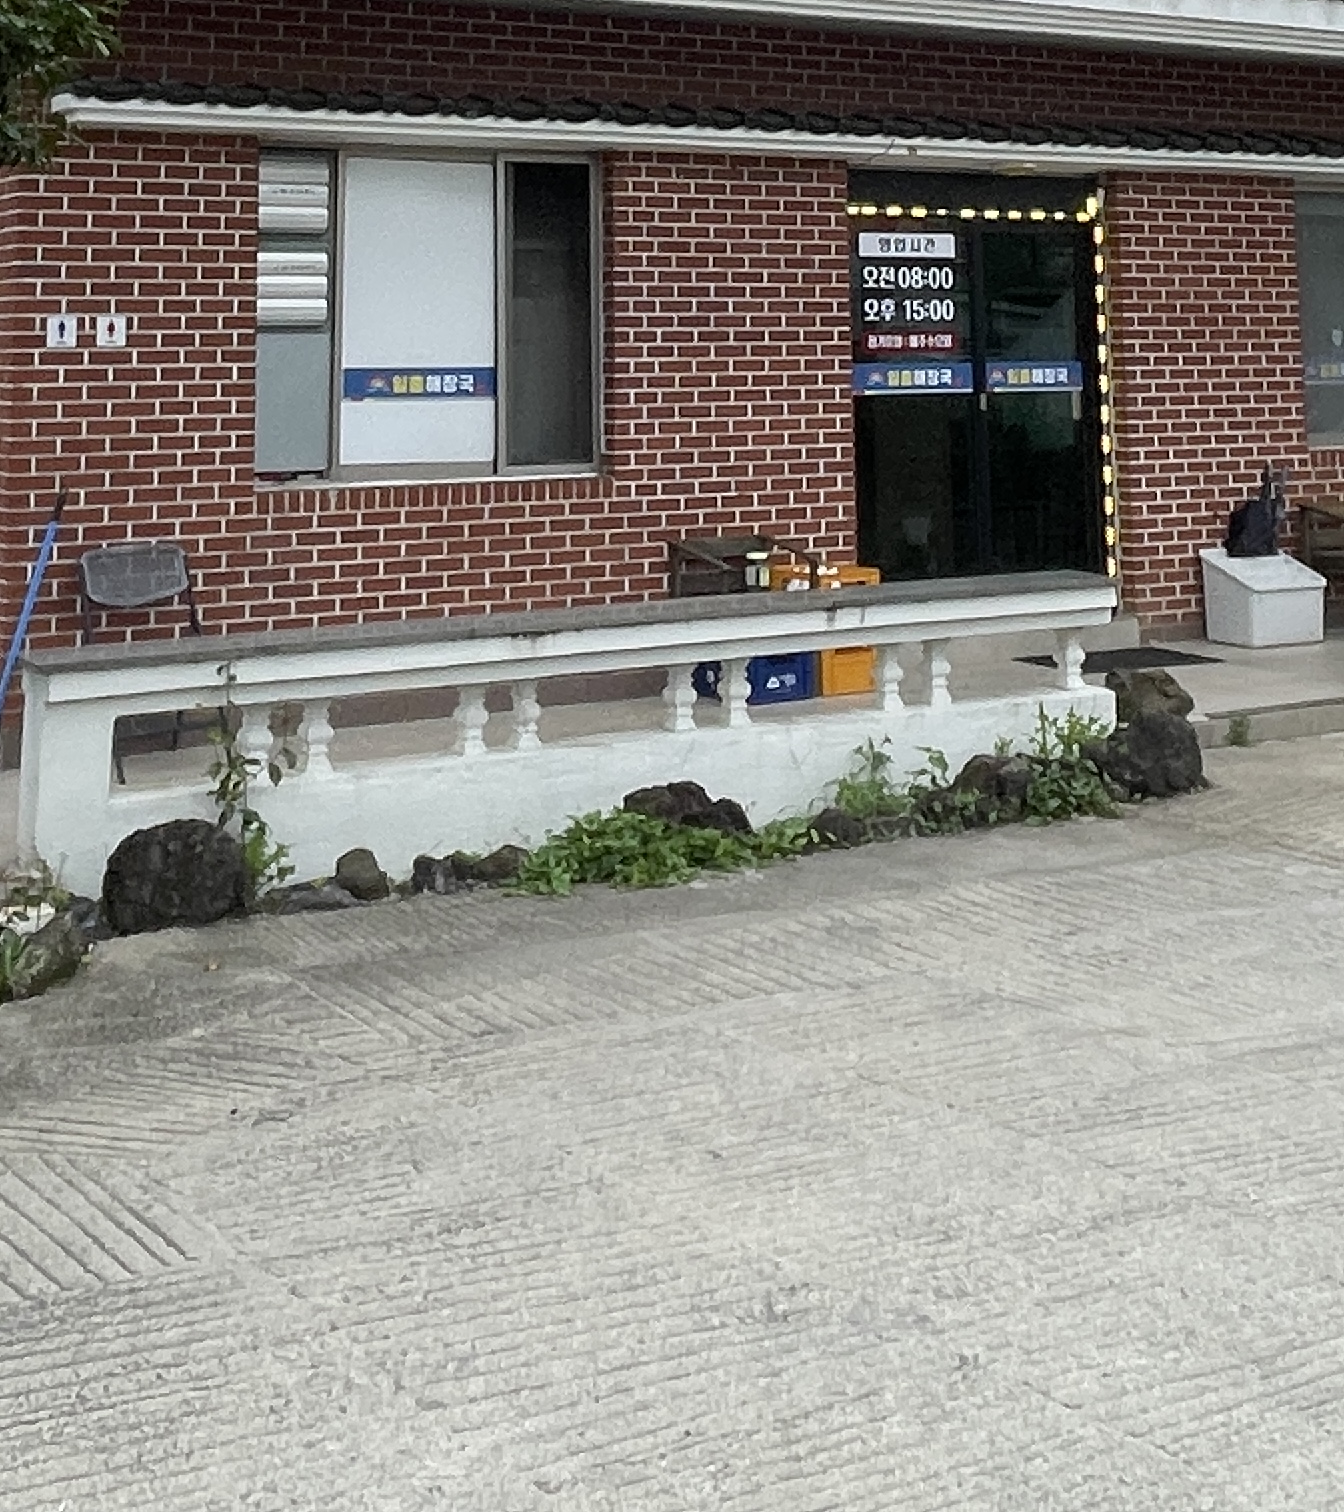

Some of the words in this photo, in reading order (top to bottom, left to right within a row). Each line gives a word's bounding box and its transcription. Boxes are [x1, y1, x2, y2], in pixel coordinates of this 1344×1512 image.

[862, 266, 896, 289] 오전
[898, 266, 954, 289] 08:00
[863, 299, 896, 322] 오후
[902, 299, 955, 321] 15:00
